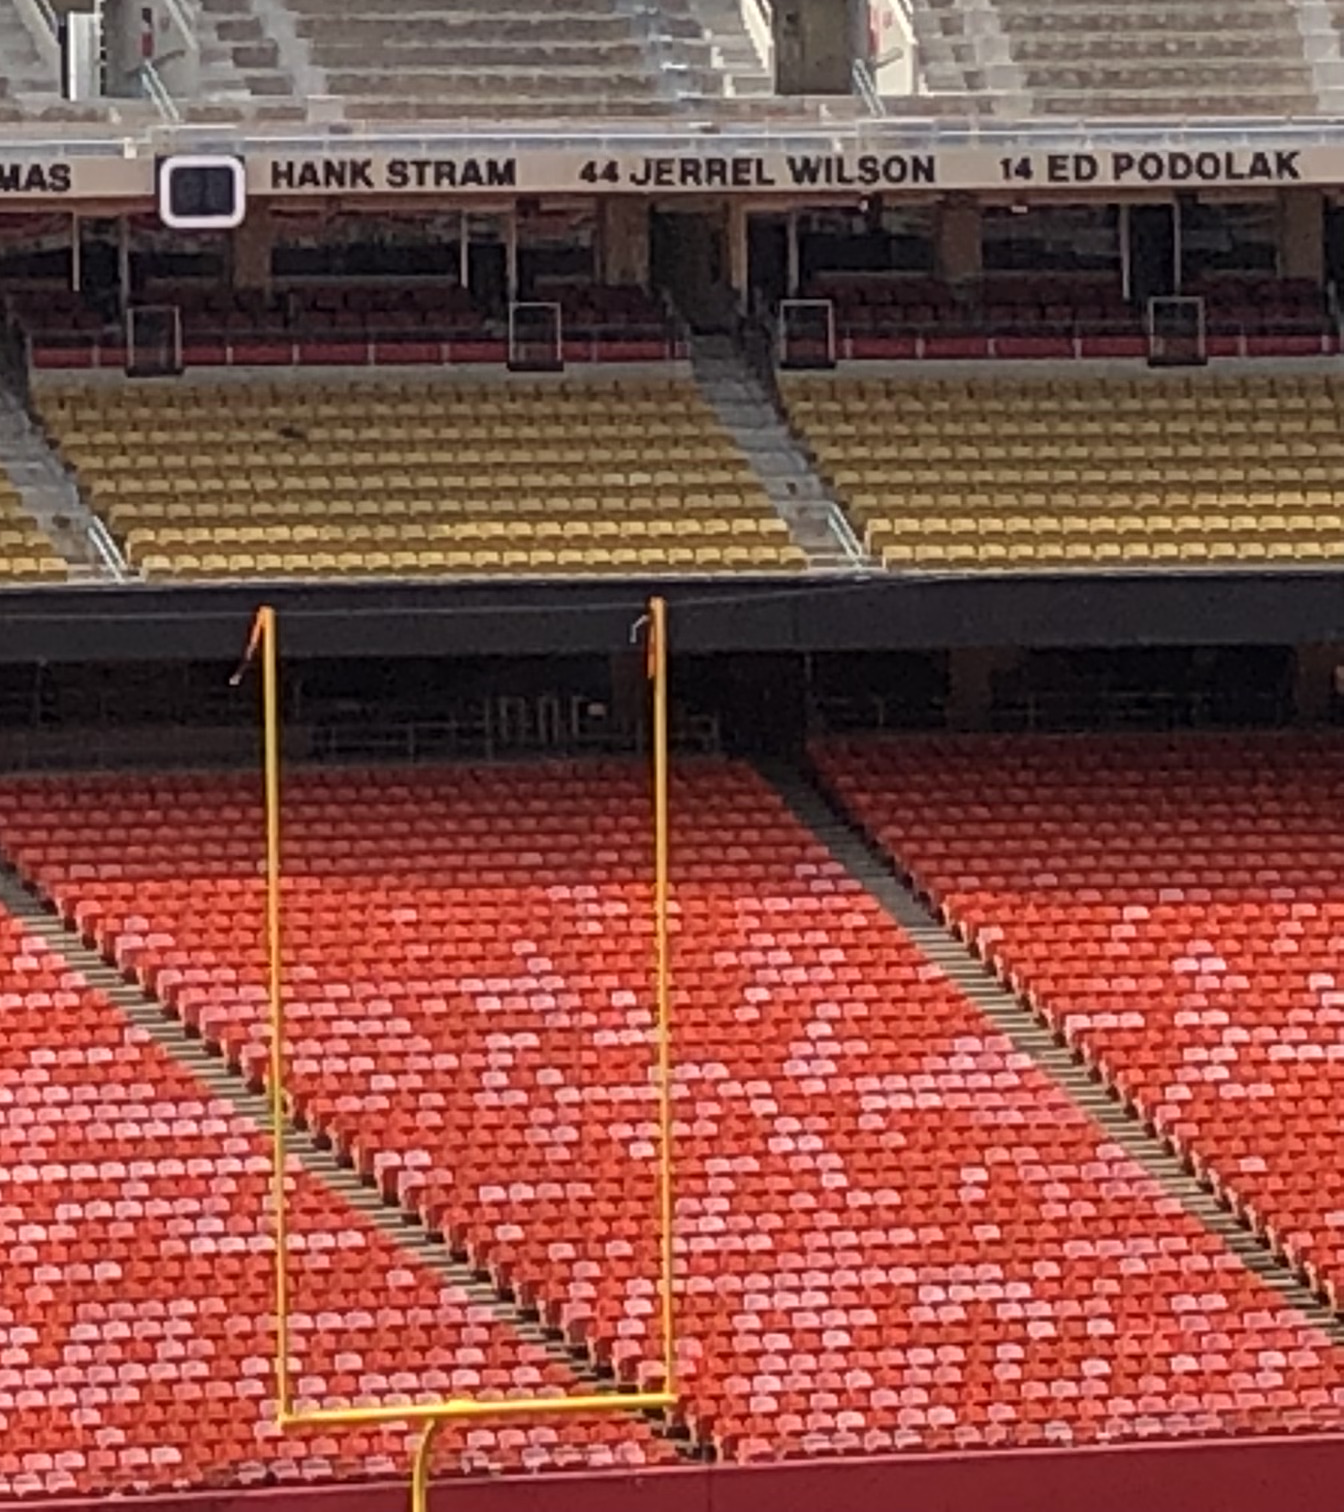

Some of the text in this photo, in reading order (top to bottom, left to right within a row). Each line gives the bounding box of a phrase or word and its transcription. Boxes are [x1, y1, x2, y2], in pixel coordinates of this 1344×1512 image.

[270, 159, 517, 189] HANK STRAM
[578, 155, 936, 186] 44 JERREL WILSON
[1000, 150, 1301, 182] 14 ED PODOLAK
